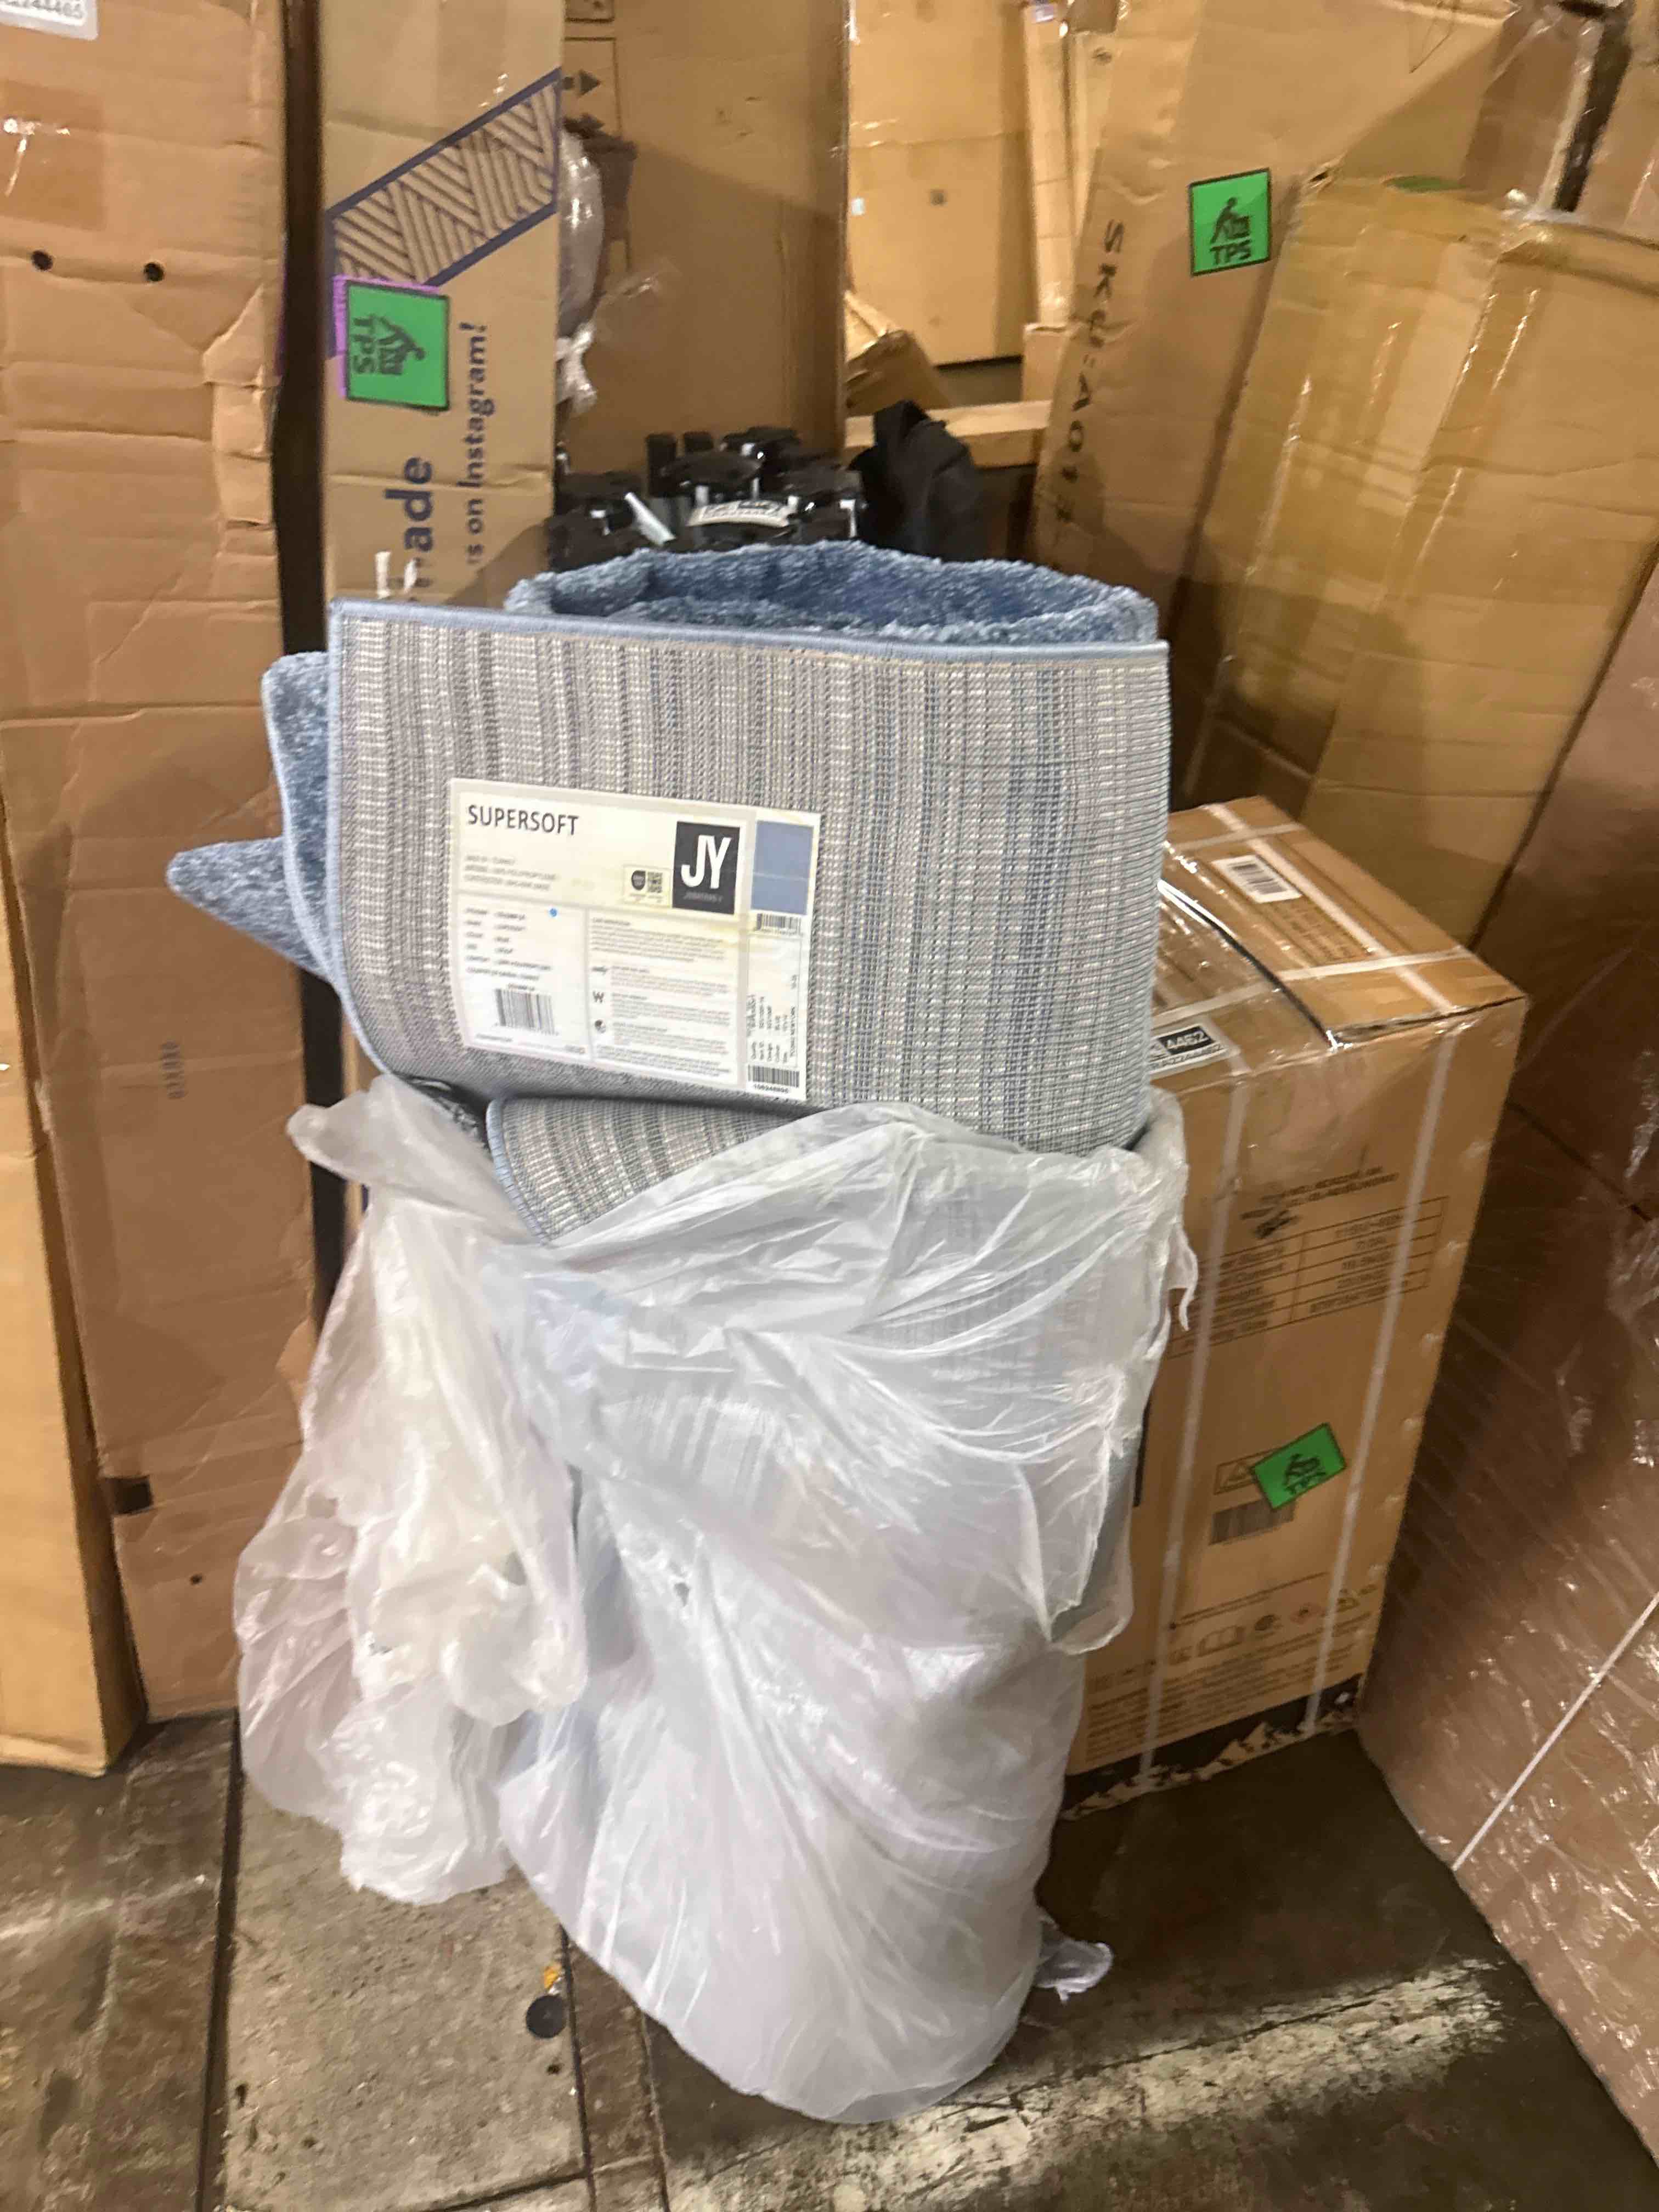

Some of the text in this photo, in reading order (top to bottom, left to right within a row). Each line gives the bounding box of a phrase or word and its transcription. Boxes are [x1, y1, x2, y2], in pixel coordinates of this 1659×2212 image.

[1210, 241, 1251, 265] TPS
[351, 317, 376, 375] TPS
[456, 321, 495, 489] Instagram!
[465, 499, 484, 535] on
[466, 803, 580, 836] SUPERSOFT
[681, 834, 732, 890] JY
